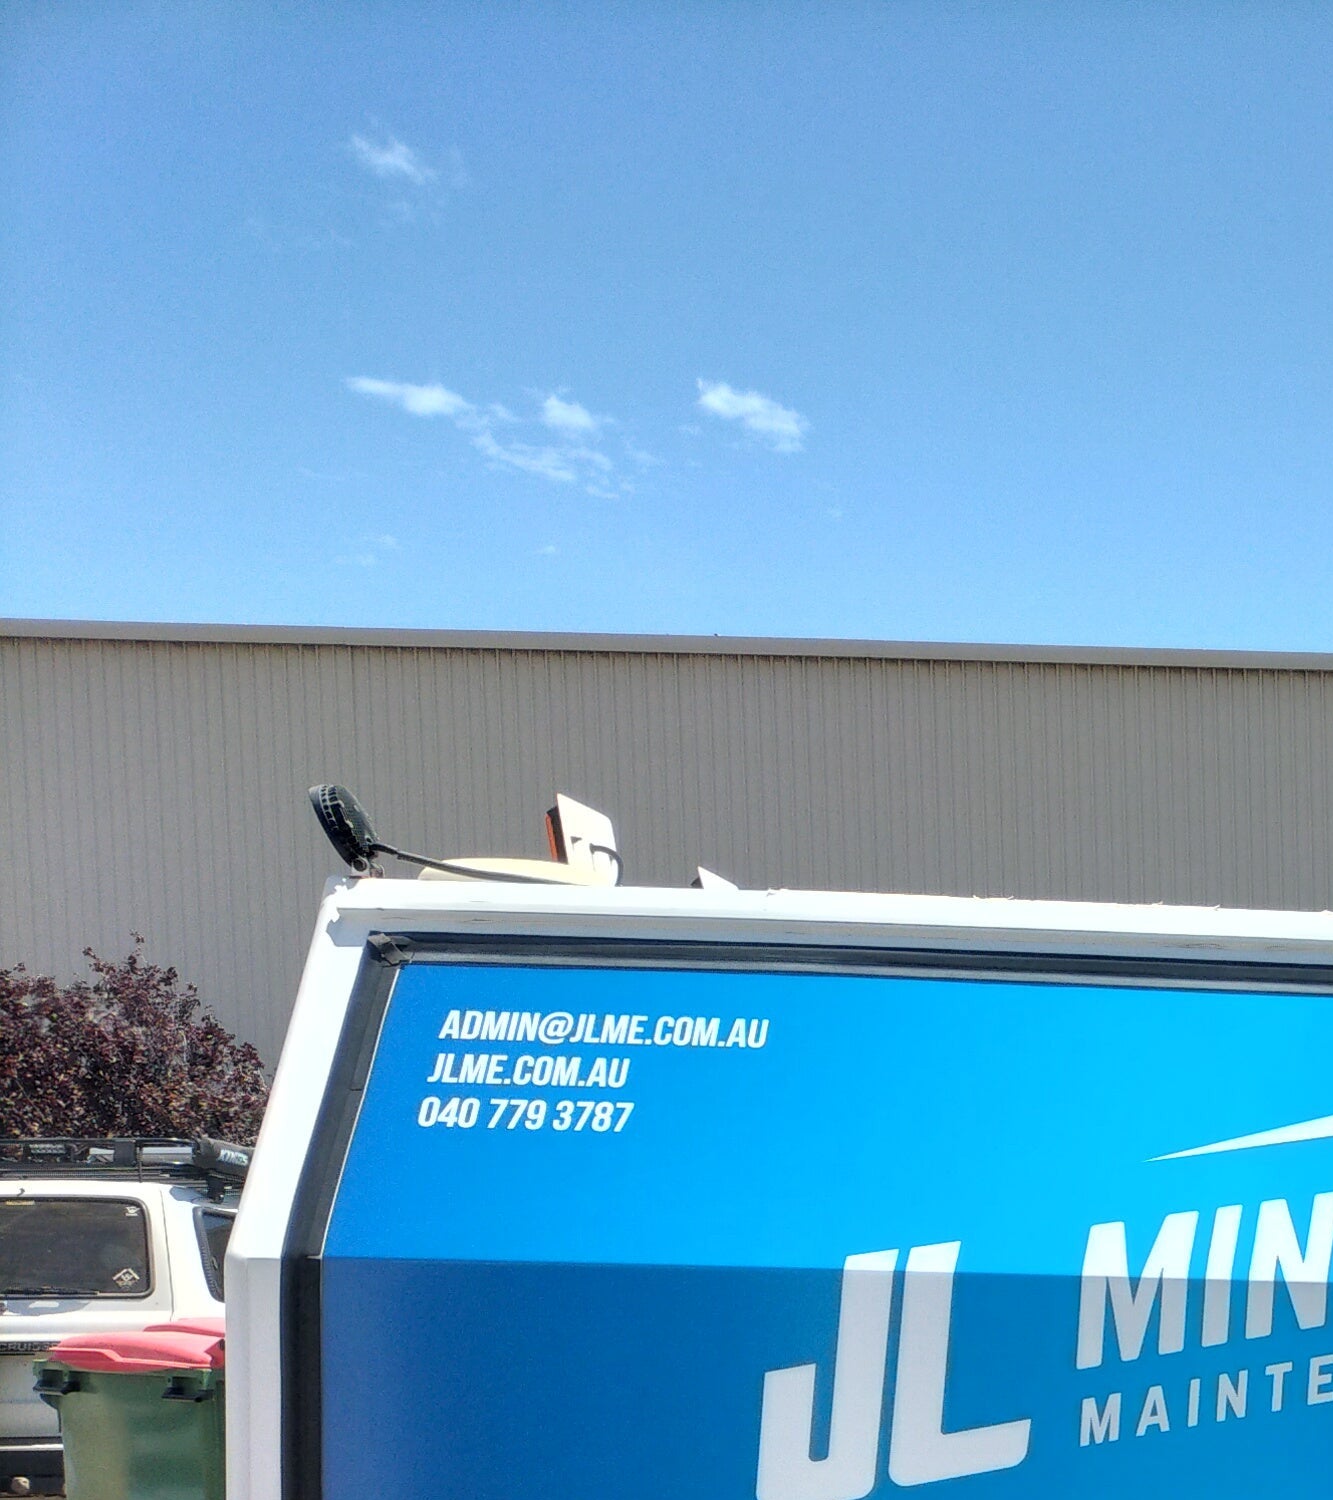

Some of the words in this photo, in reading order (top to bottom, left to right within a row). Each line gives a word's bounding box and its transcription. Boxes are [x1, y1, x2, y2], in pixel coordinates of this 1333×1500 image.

[439, 1009, 769, 1049] ADMIN@JLME.COM.AU
[427, 1053, 630, 1090] JLME.COM.AU
[418, 1096, 480, 1130] 040
[487, 1097, 545, 1132] 779
[553, 1099, 634, 1134] 3787
